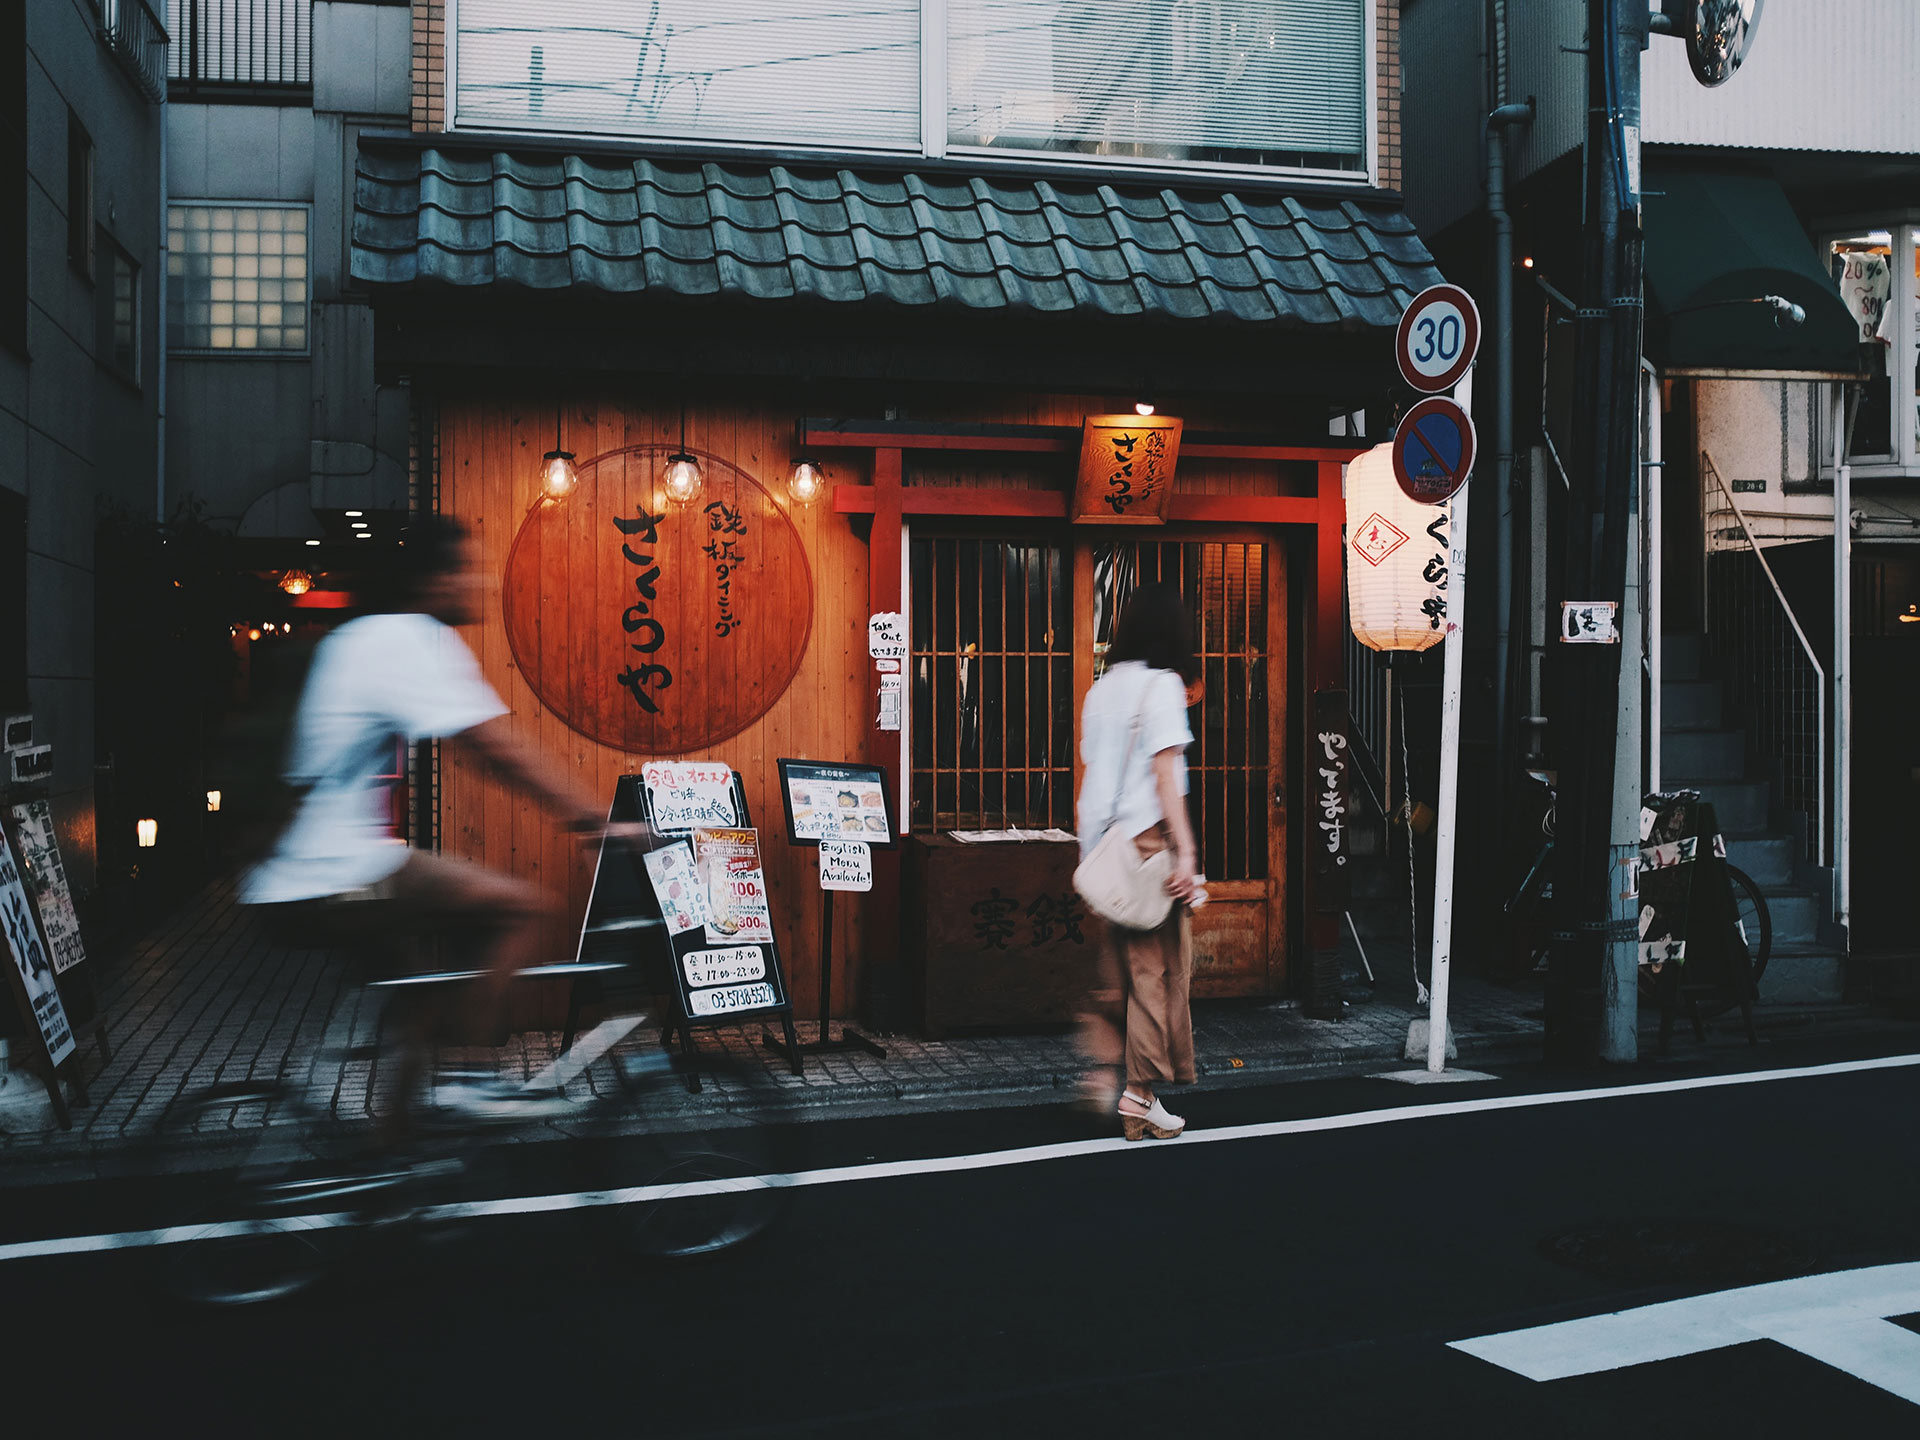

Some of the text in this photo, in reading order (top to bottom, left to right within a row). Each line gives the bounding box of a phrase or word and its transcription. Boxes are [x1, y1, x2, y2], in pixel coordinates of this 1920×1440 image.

[1415, 315, 1460, 362] 30
[1104, 433, 1139, 514] さくらや
[613, 504, 672, 714] さくらや
[872, 622, 893, 632] Take
[881, 633, 902, 642] Out
[830, 857, 860, 869] Menu
